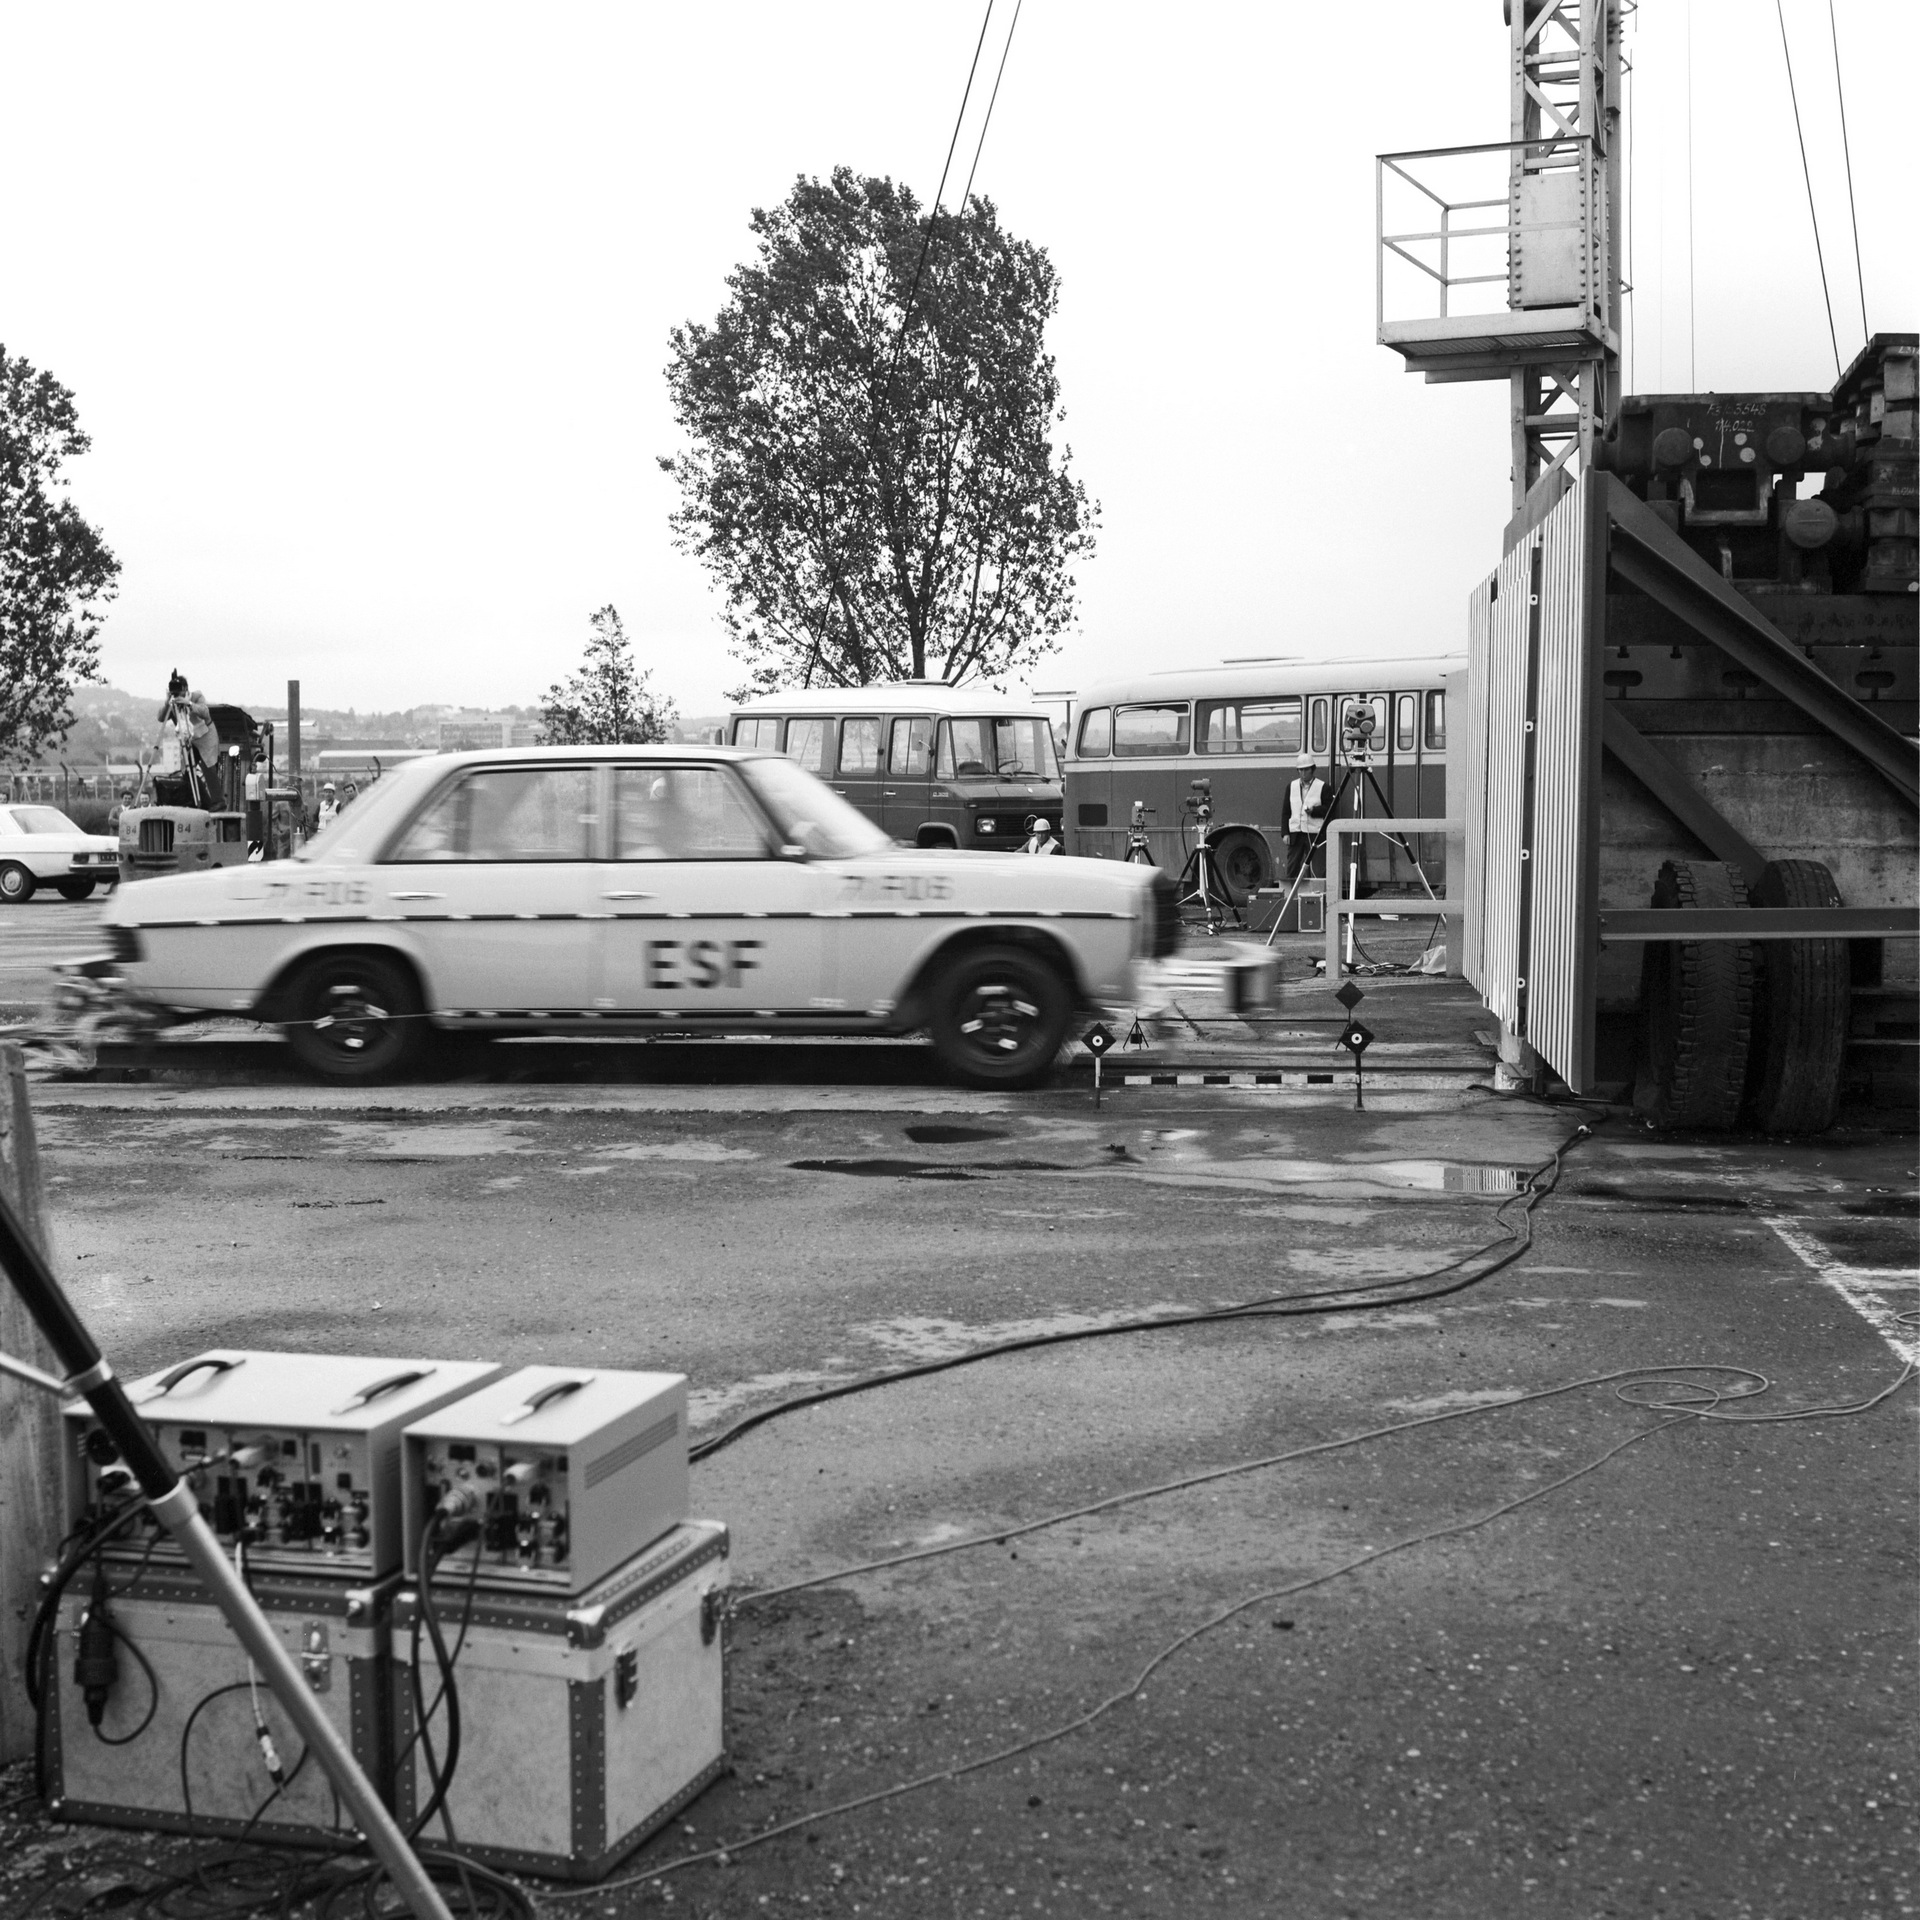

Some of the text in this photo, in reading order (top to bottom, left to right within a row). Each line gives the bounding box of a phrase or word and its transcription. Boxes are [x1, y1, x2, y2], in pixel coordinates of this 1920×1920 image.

[125, 825, 137, 835] 84
[177, 823, 192, 833] 84
[644, 940, 766, 989] ESF
